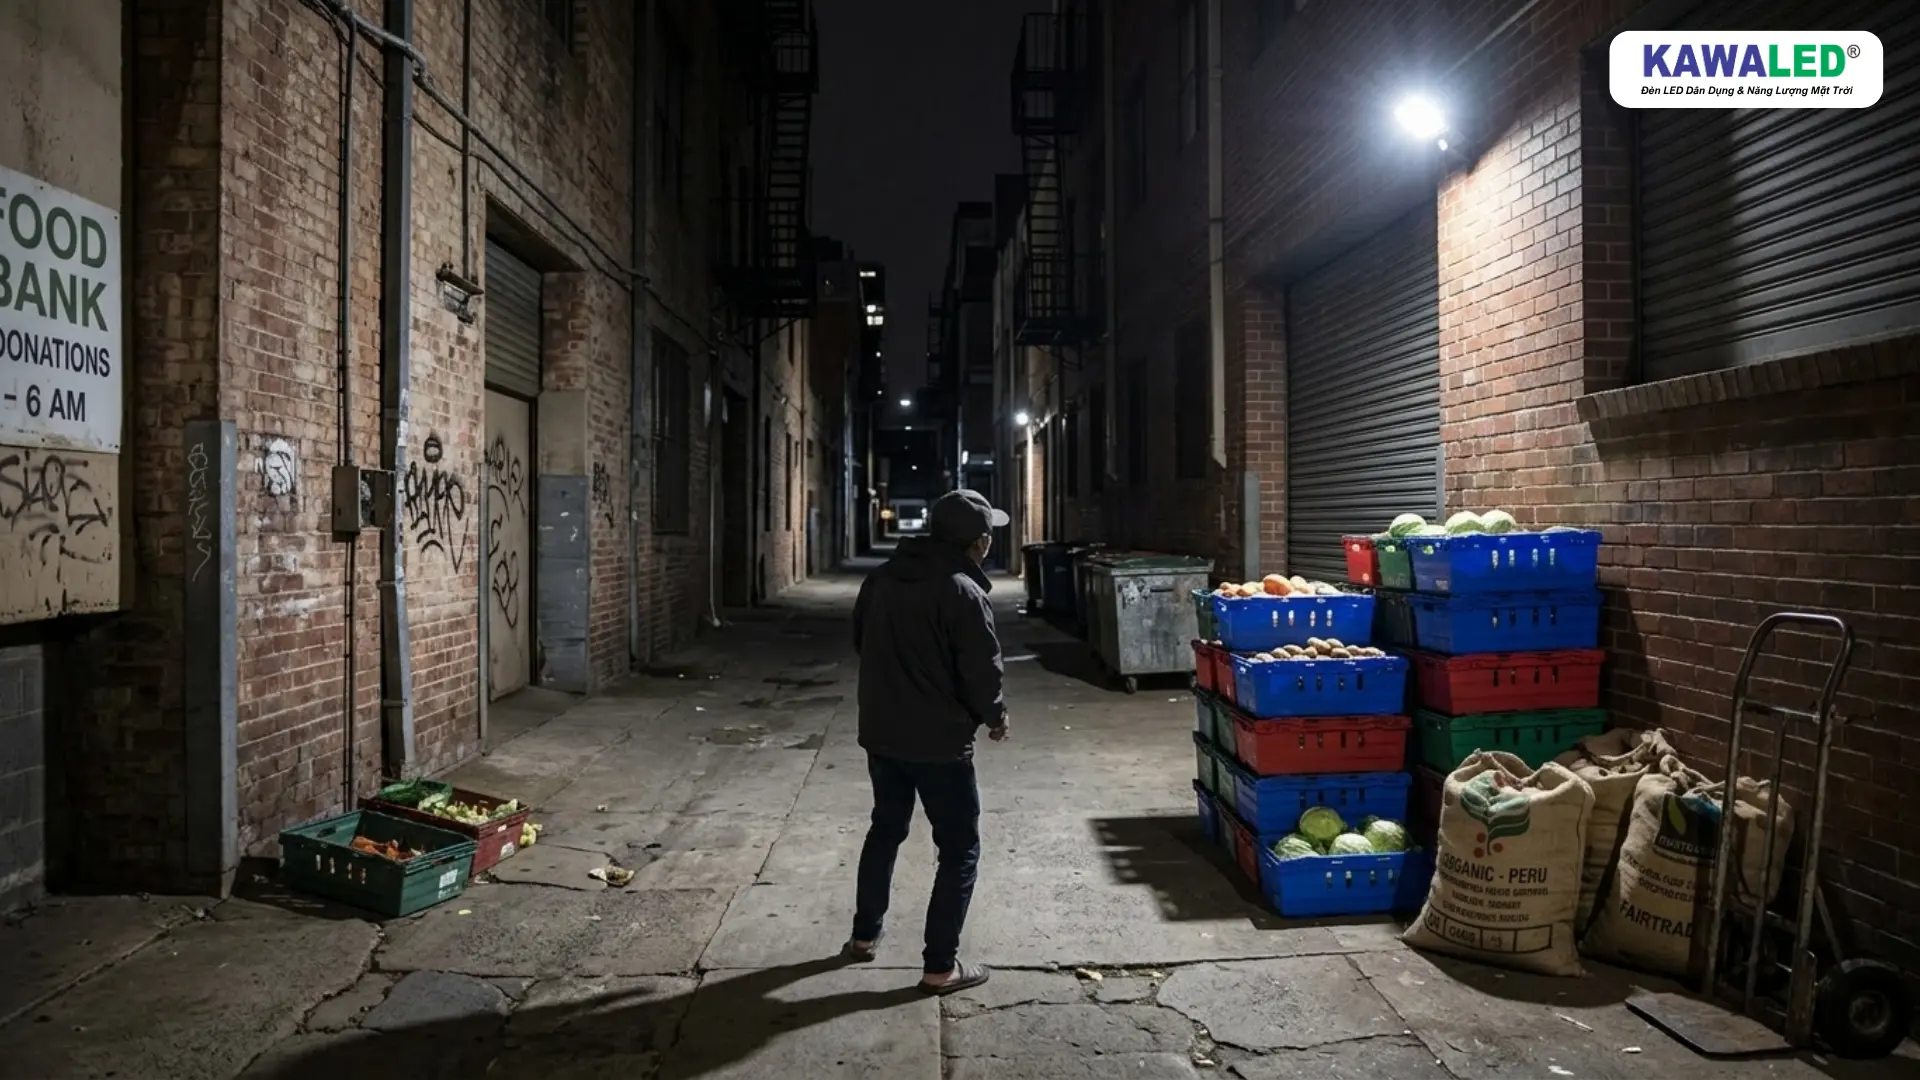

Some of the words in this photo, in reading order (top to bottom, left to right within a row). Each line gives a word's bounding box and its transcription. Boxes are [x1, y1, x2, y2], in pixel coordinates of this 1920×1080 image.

[0, 186, 107, 269] OOD
[26, 384, 41, 418] 6
[49, 388, 86, 422] AM
[1508, 867, 1548, 884] PERU
